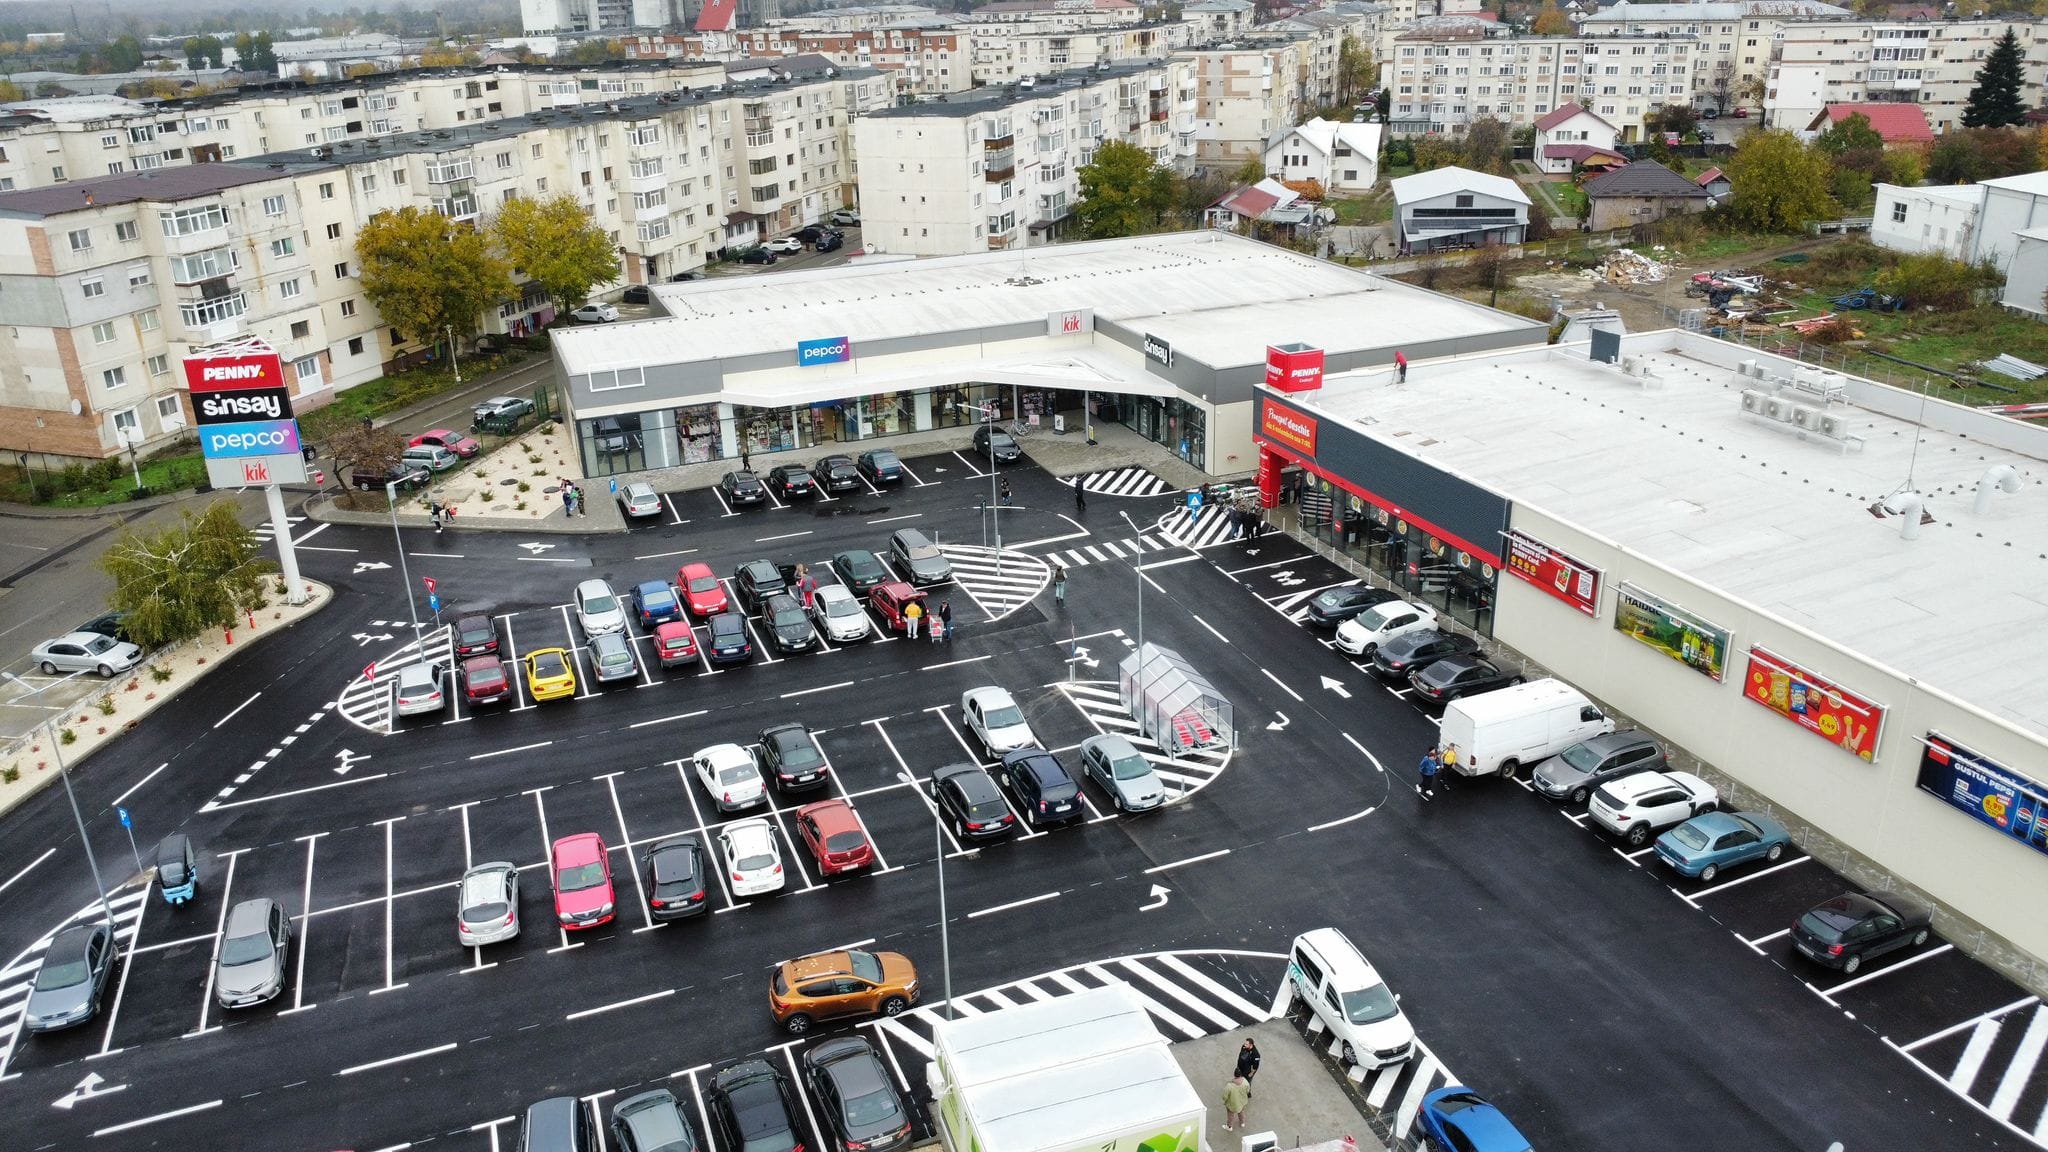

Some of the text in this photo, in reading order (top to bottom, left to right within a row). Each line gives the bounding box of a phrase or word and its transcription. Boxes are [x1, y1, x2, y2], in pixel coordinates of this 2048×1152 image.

[1063, 315, 1080, 332] kik
[1144, 338, 1168, 364] sinsay
[203, 394, 281, 418] sinsay
[245, 460, 268, 481] kik
[1954, 763, 1988, 785] GUSTUL
[1989, 779, 2015, 797] PEPSI
